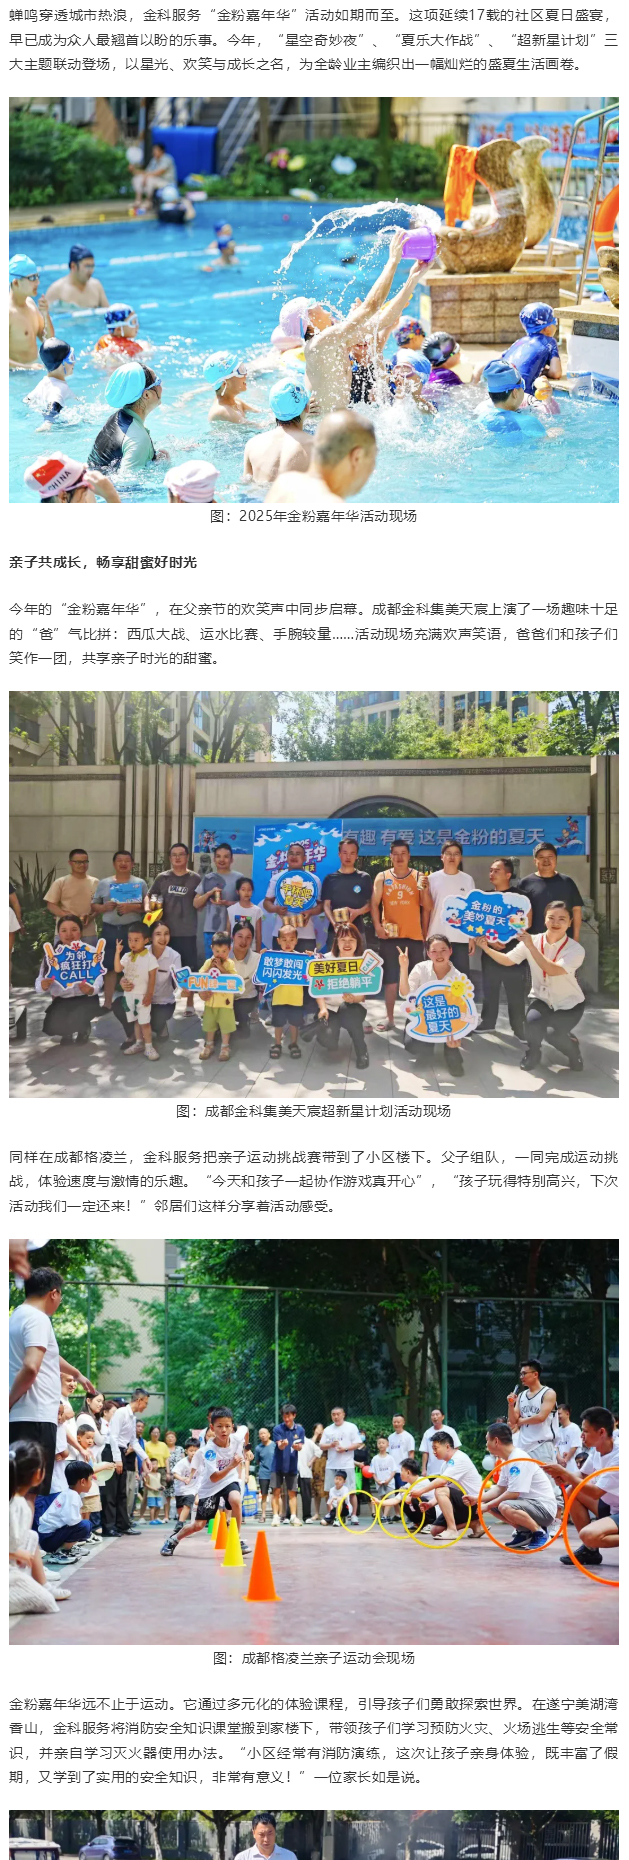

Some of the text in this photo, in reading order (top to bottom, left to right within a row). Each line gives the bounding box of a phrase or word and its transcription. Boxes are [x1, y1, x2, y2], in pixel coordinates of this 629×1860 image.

[48, 471, 72, 491] CHINA
[419, 829, 545, 846] 这是金粉的夏天
[284, 895, 304, 908] 夏天
[397, 890, 403, 900] 9
[471, 900, 503, 914] 金粉的
[463, 910, 507, 926] 美妙夏天
[65, 951, 87, 960] 为邻
[61, 960, 92, 970] 疯狂打
[263, 957, 304, 969] 敢梦敢闯
[313, 961, 358, 974] 美好夏日
[60, 970, 94, 980] CALL
[262, 967, 303, 980] 闪闪发光
[327, 976, 372, 990] 拒绝躺平
[424, 995, 446, 1008] 这是
[426, 1006, 459, 1020] 最好的
[427, 1020, 451, 1033] 夏天
